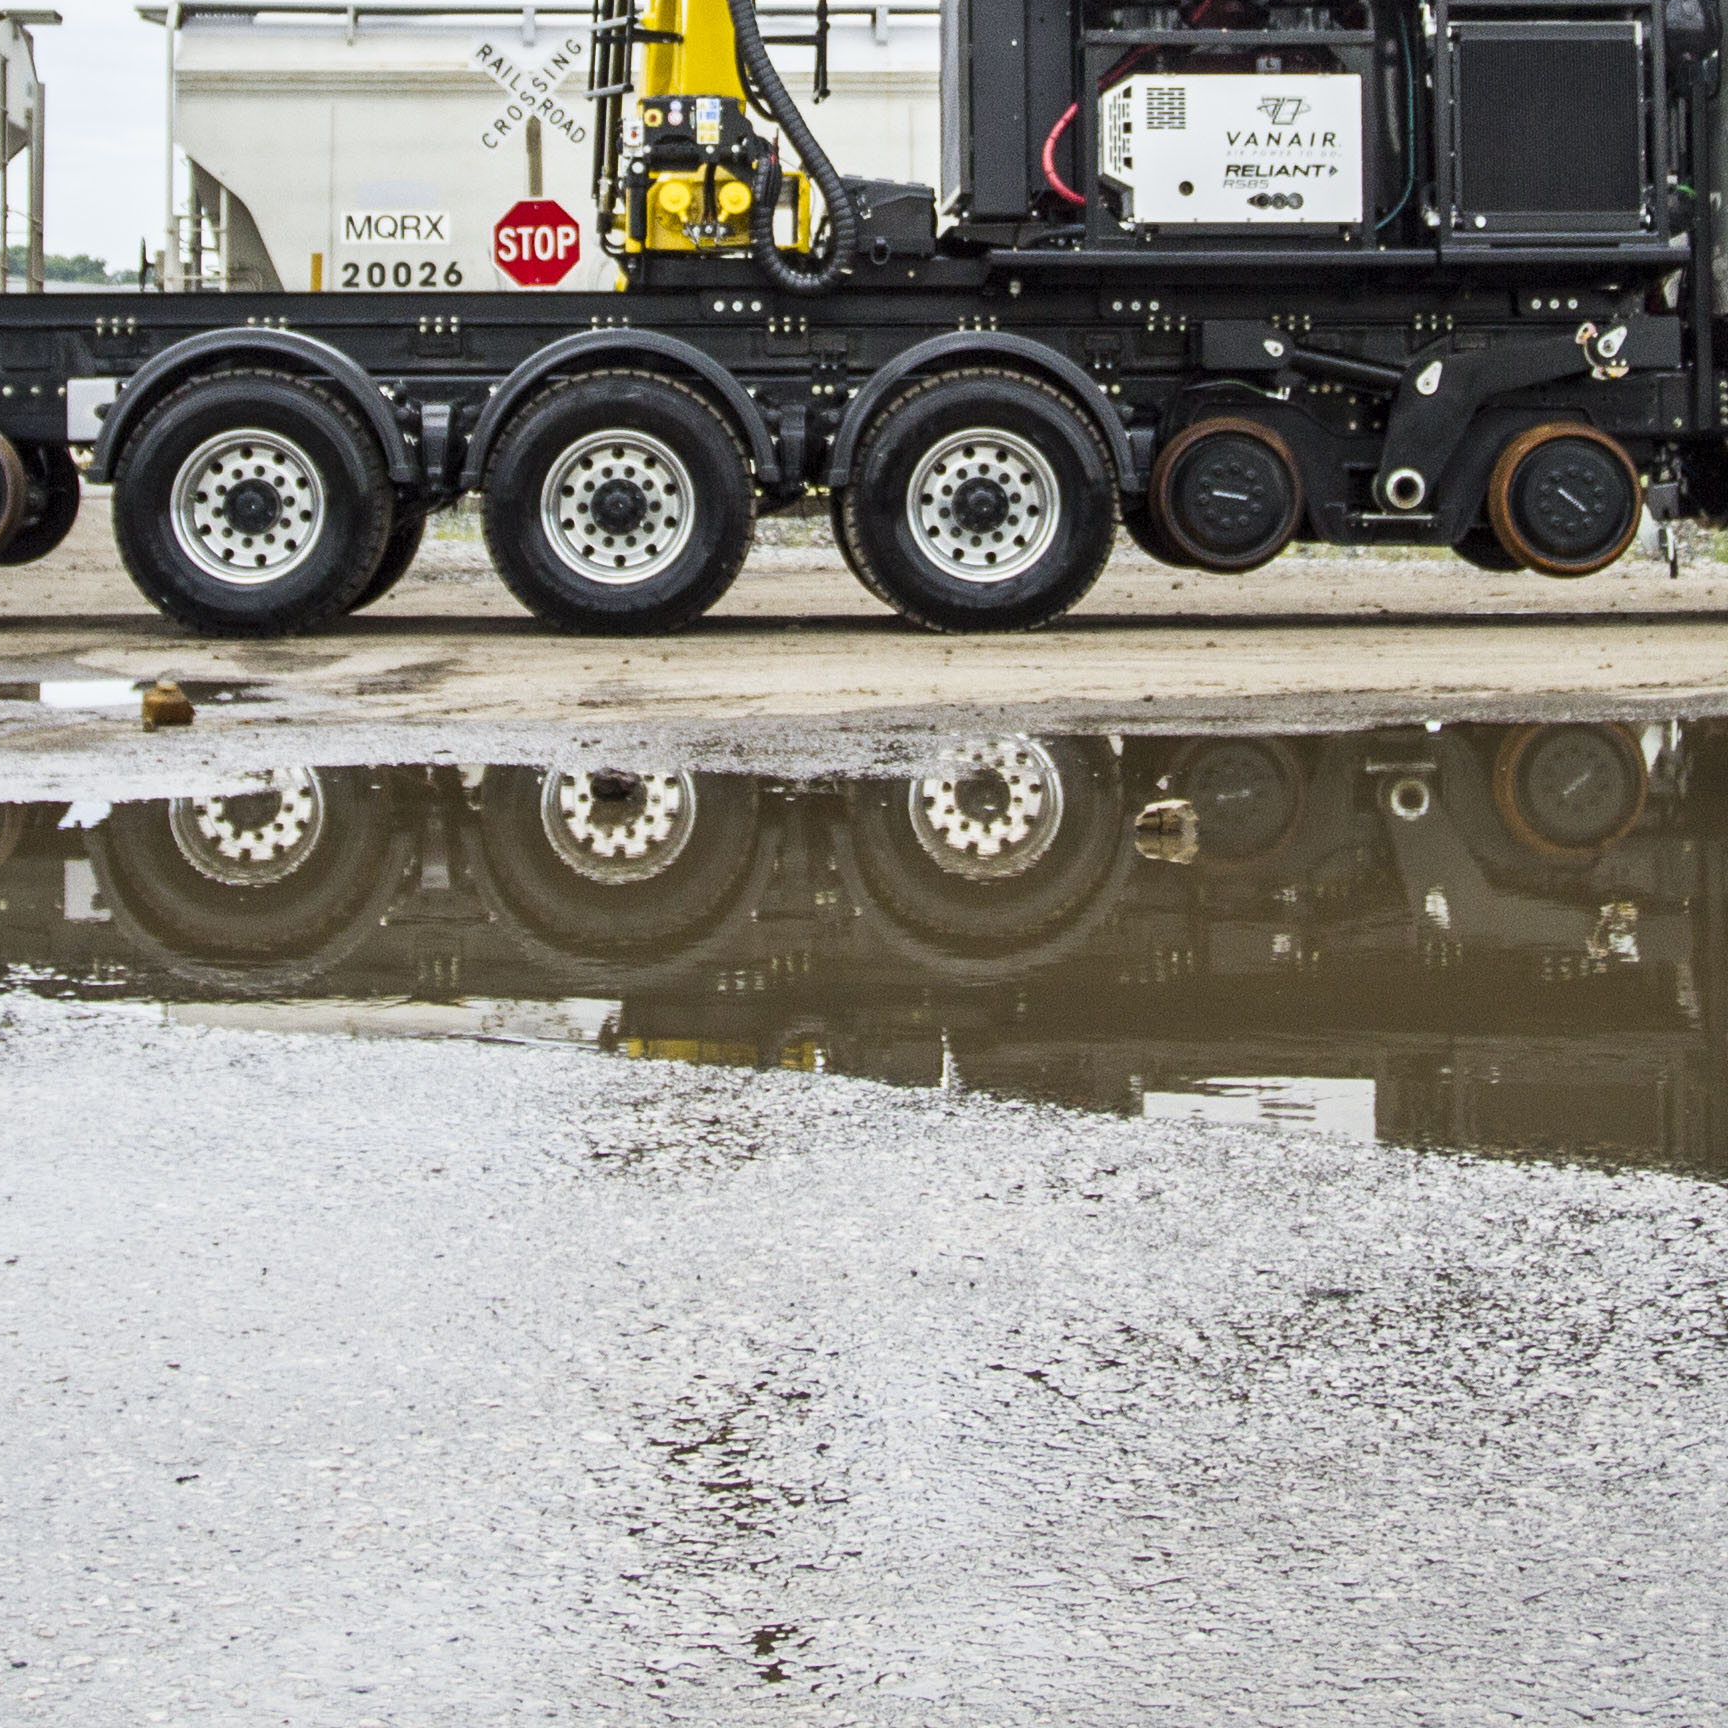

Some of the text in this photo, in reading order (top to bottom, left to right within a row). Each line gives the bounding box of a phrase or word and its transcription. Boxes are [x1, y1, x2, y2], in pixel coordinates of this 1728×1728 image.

[475, 43, 586, 143] RAILROAD
[481, 39, 582, 149] CROSSING
[1226, 131, 1336, 147] VANAIR
[1225, 164, 1326, 177] RELIANT
[345, 215, 444, 241] MQRX
[498, 226, 577, 262] STOP
[342, 262, 463, 288] 20026
